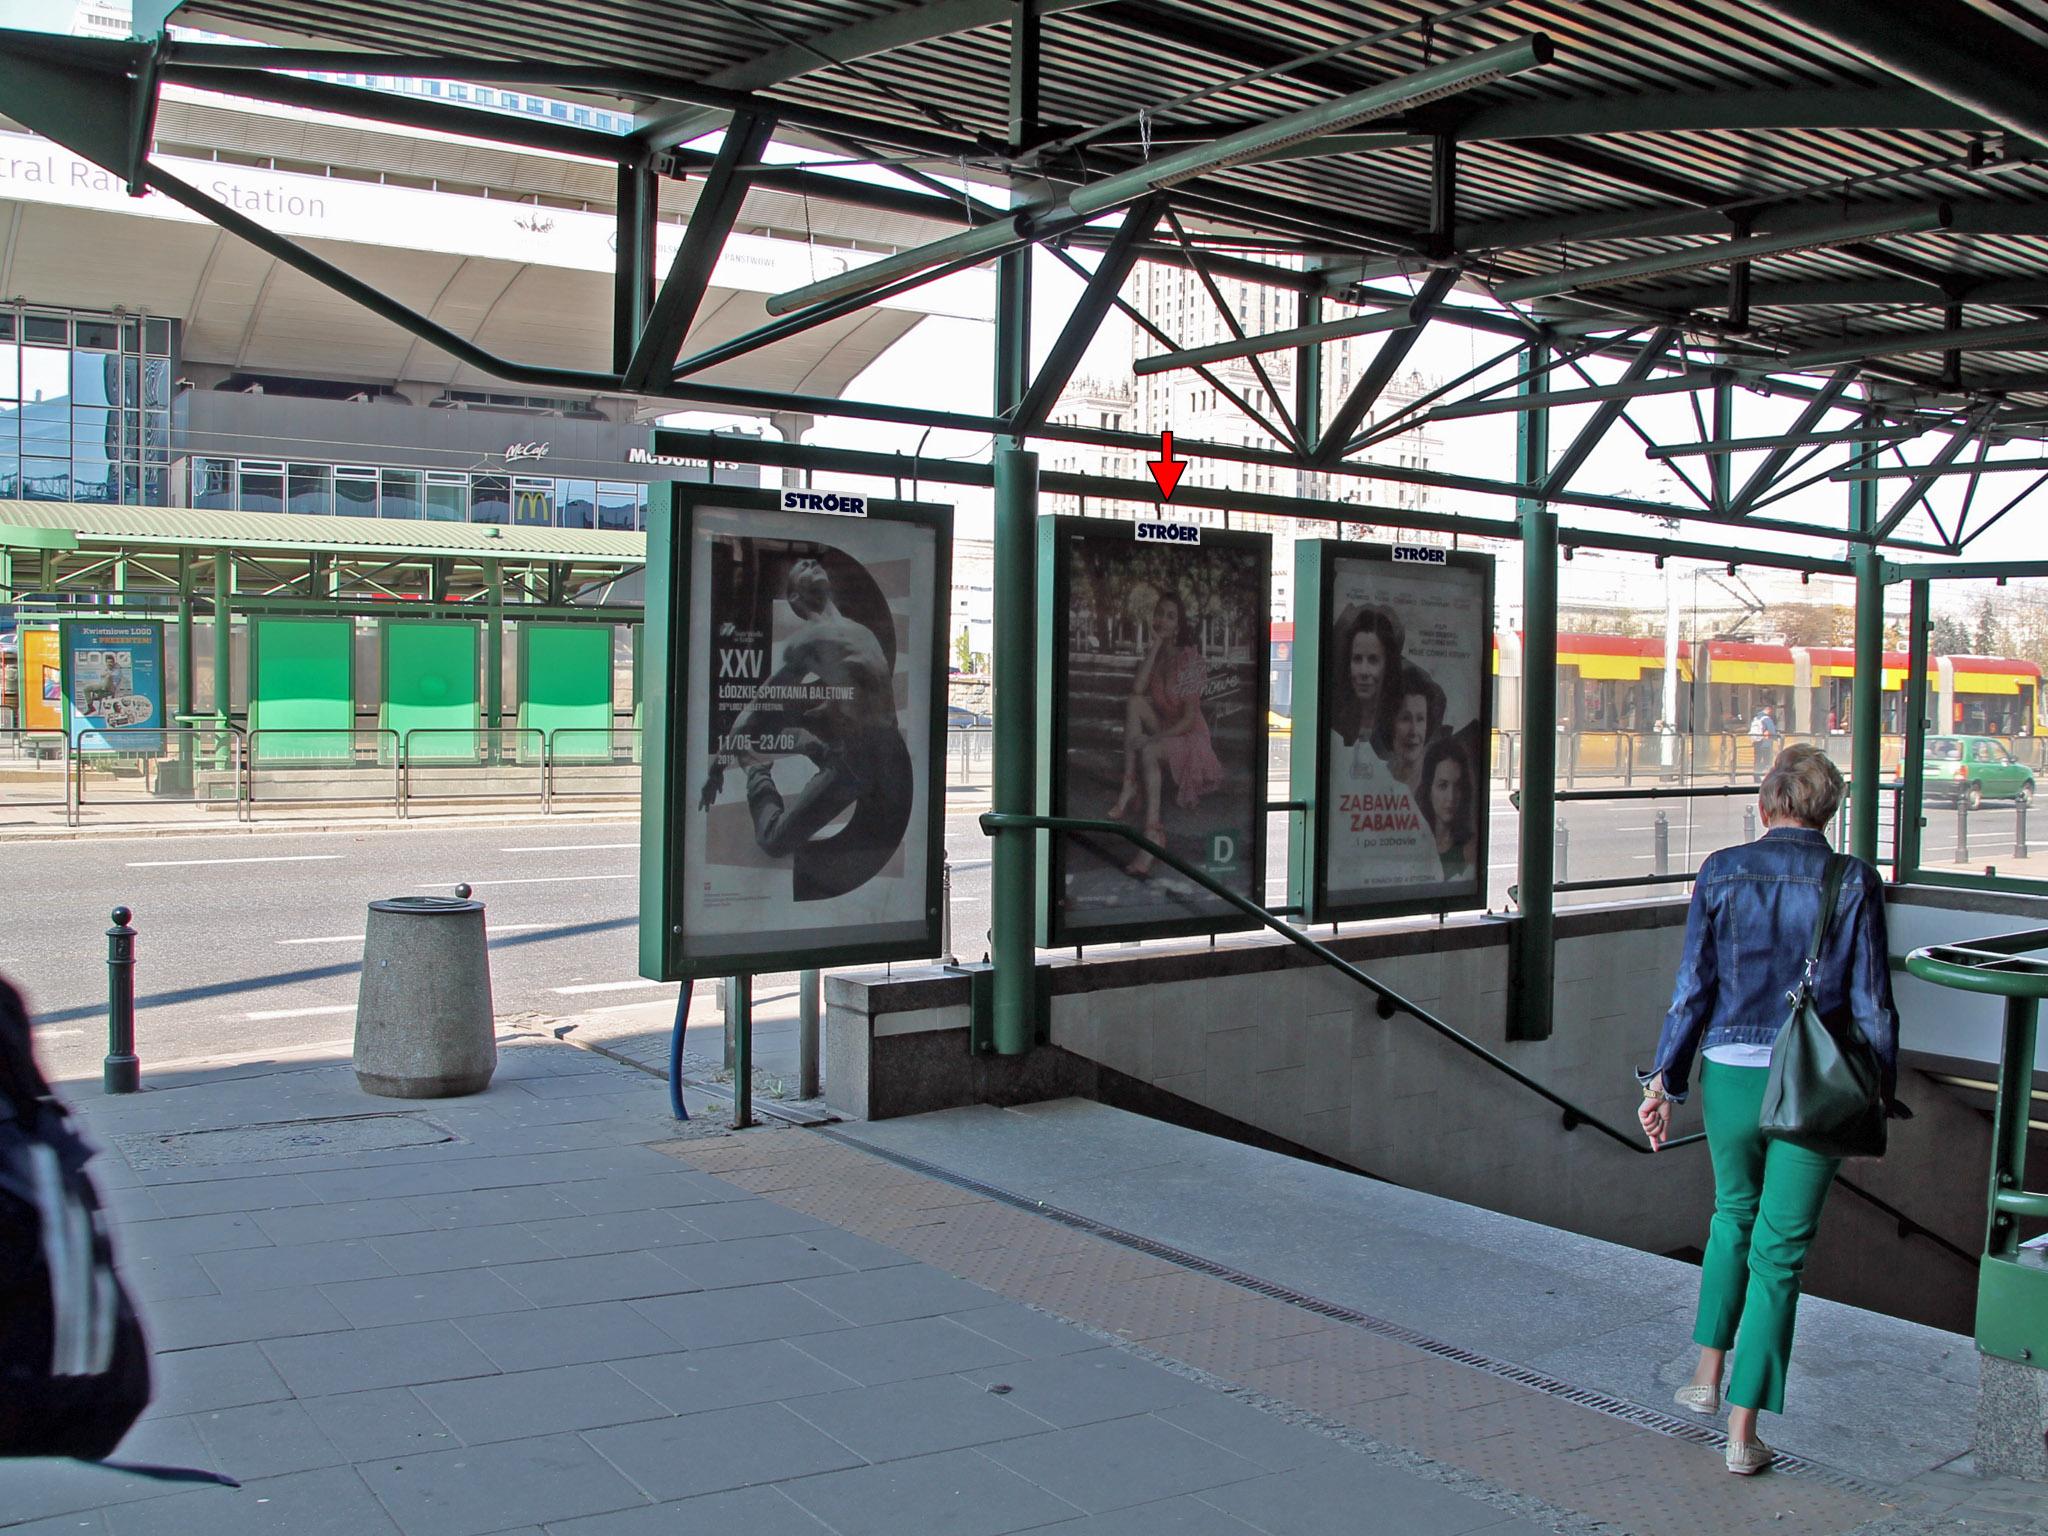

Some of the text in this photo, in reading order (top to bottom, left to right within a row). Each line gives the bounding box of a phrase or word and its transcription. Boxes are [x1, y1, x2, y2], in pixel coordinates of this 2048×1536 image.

[212, 180, 324, 218] Station
[784, 492, 864, 513] STRÖER
[1138, 523, 1198, 541] STRÖER
[1394, 547, 1445, 562] STRÖER
[719, 648, 764, 679] XXV
[718, 683, 855, 700] ŁÓDZKIE SPOTKANIA BALETOWE
[1339, 794, 1410, 812] ZABAWA
[1351, 814, 1420, 832] ZABAWA
[1213, 835, 1234, 863] D
[1364, 838, 1376, 848] po
